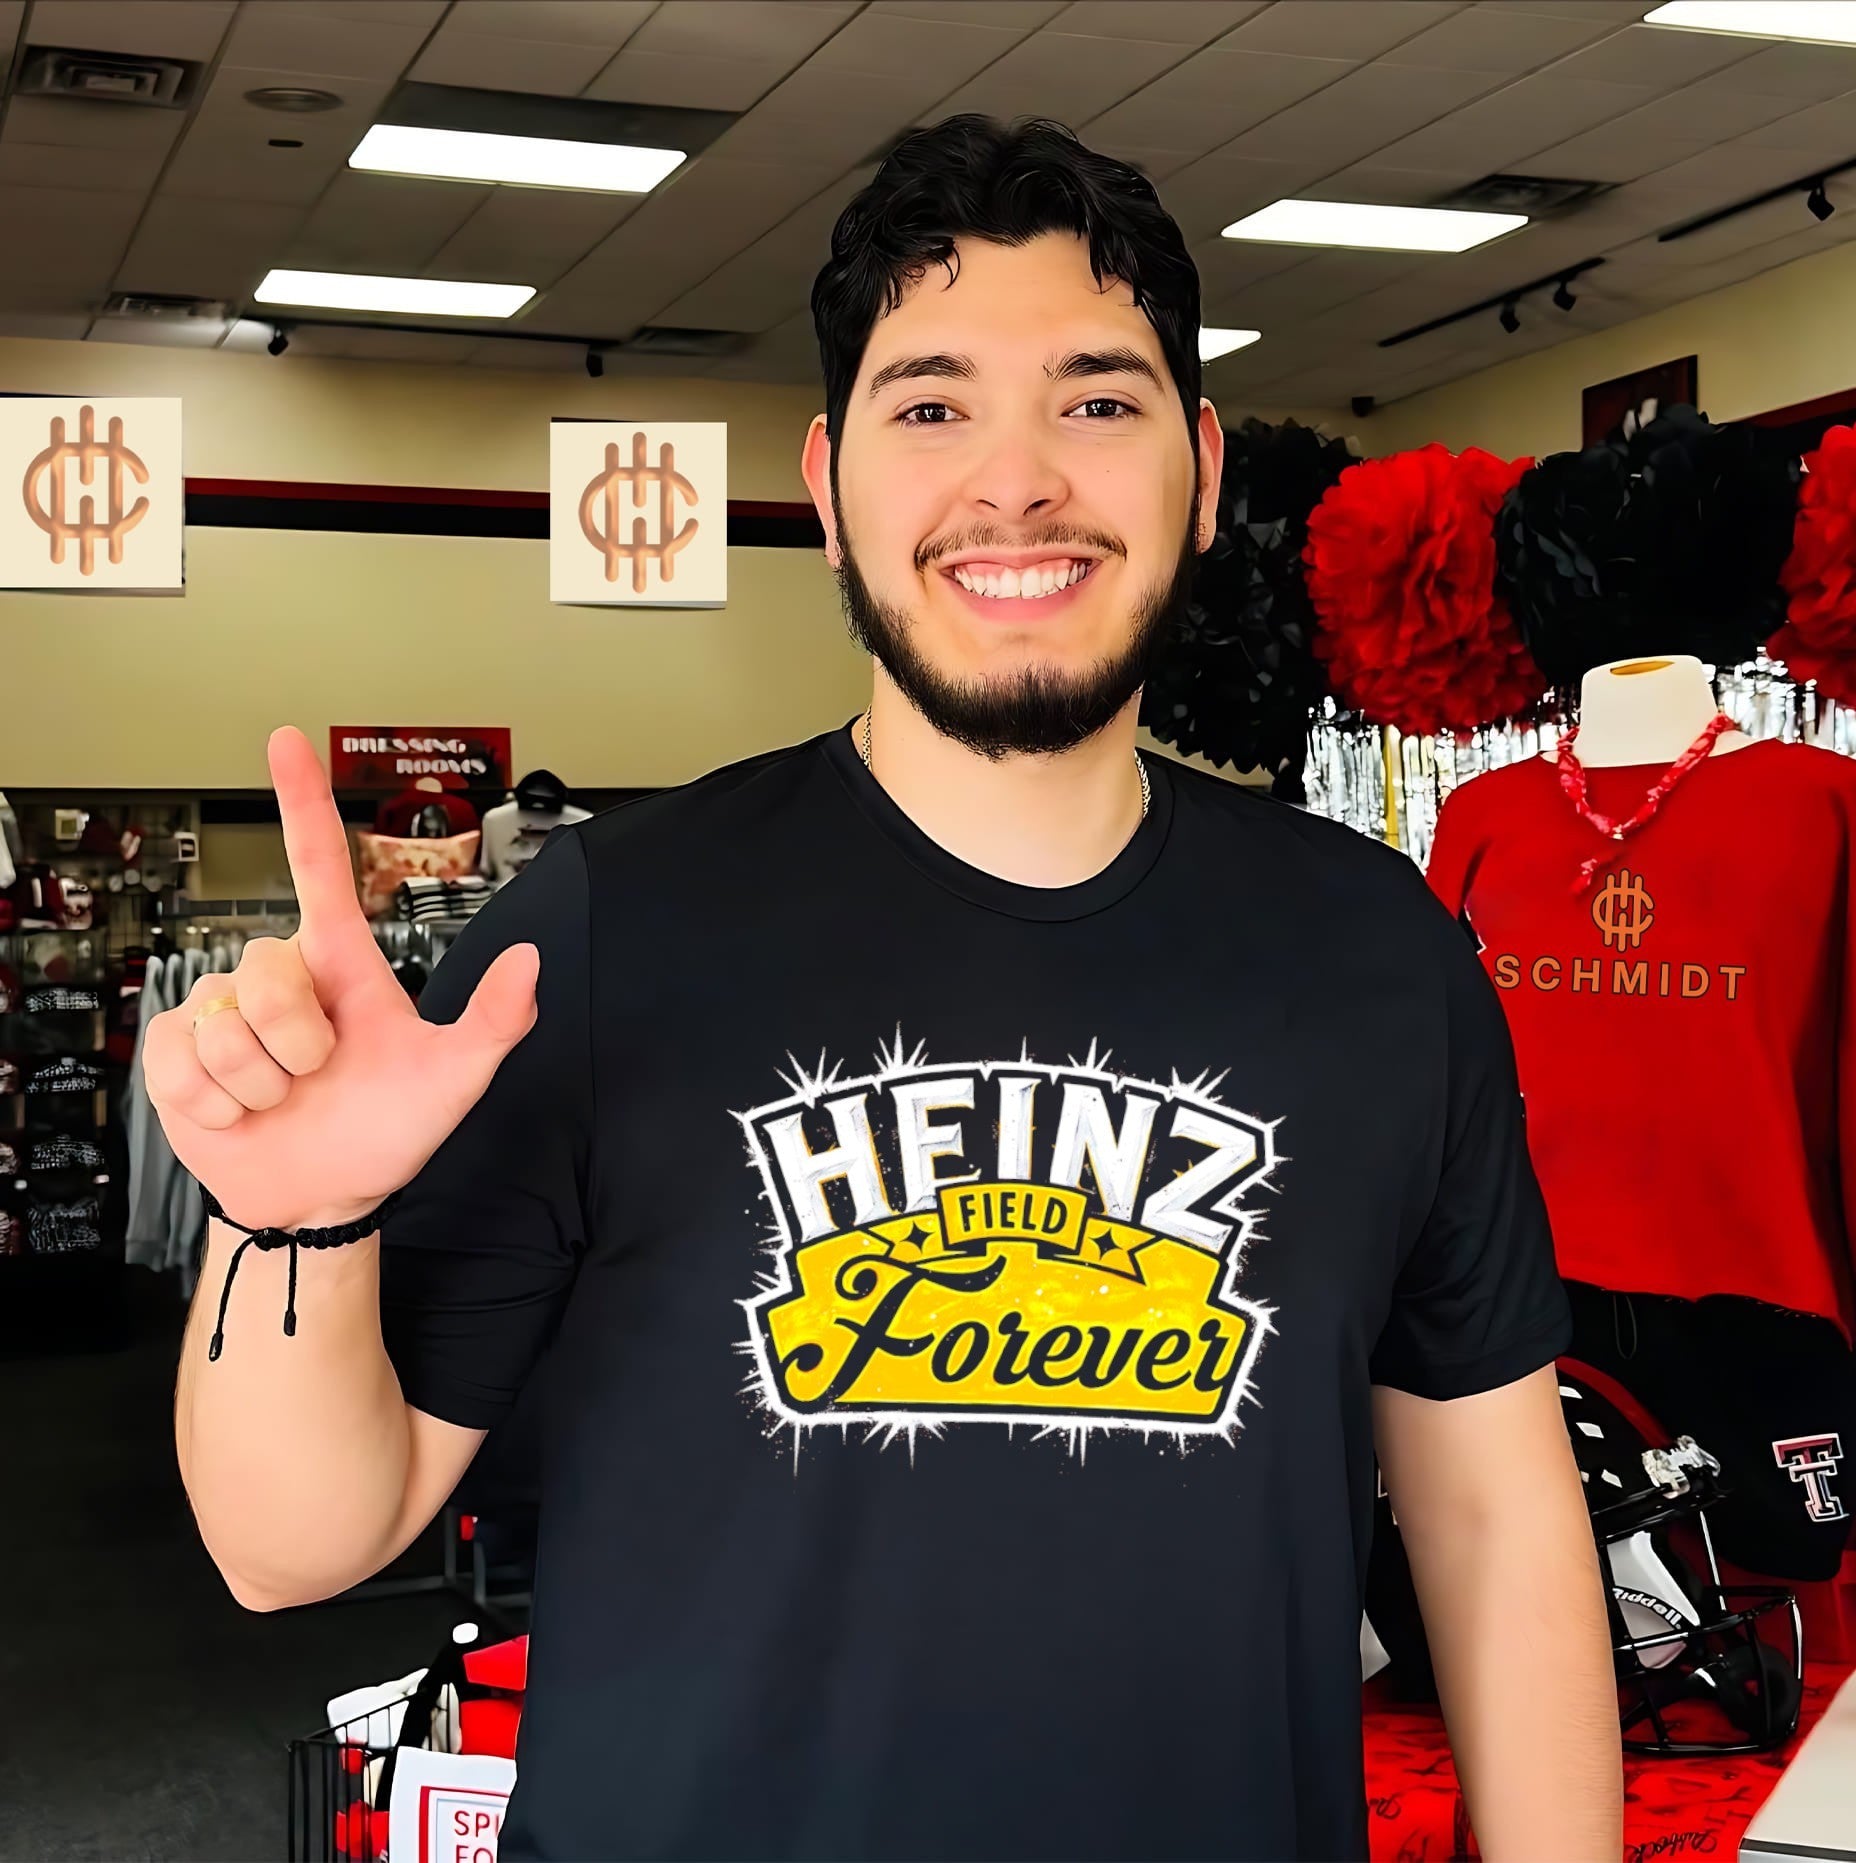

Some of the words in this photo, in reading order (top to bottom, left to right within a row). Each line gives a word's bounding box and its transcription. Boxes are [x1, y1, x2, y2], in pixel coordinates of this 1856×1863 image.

[342, 737, 467, 753] DRESSING
[396, 758, 487, 775] ROOMS
[1494, 954, 1746, 1000] SCHMIDT
[762, 1076, 1258, 1255] HEINZ
[957, 1189, 1068, 1234] FIELD
[783, 1252, 1234, 1402] Forever
